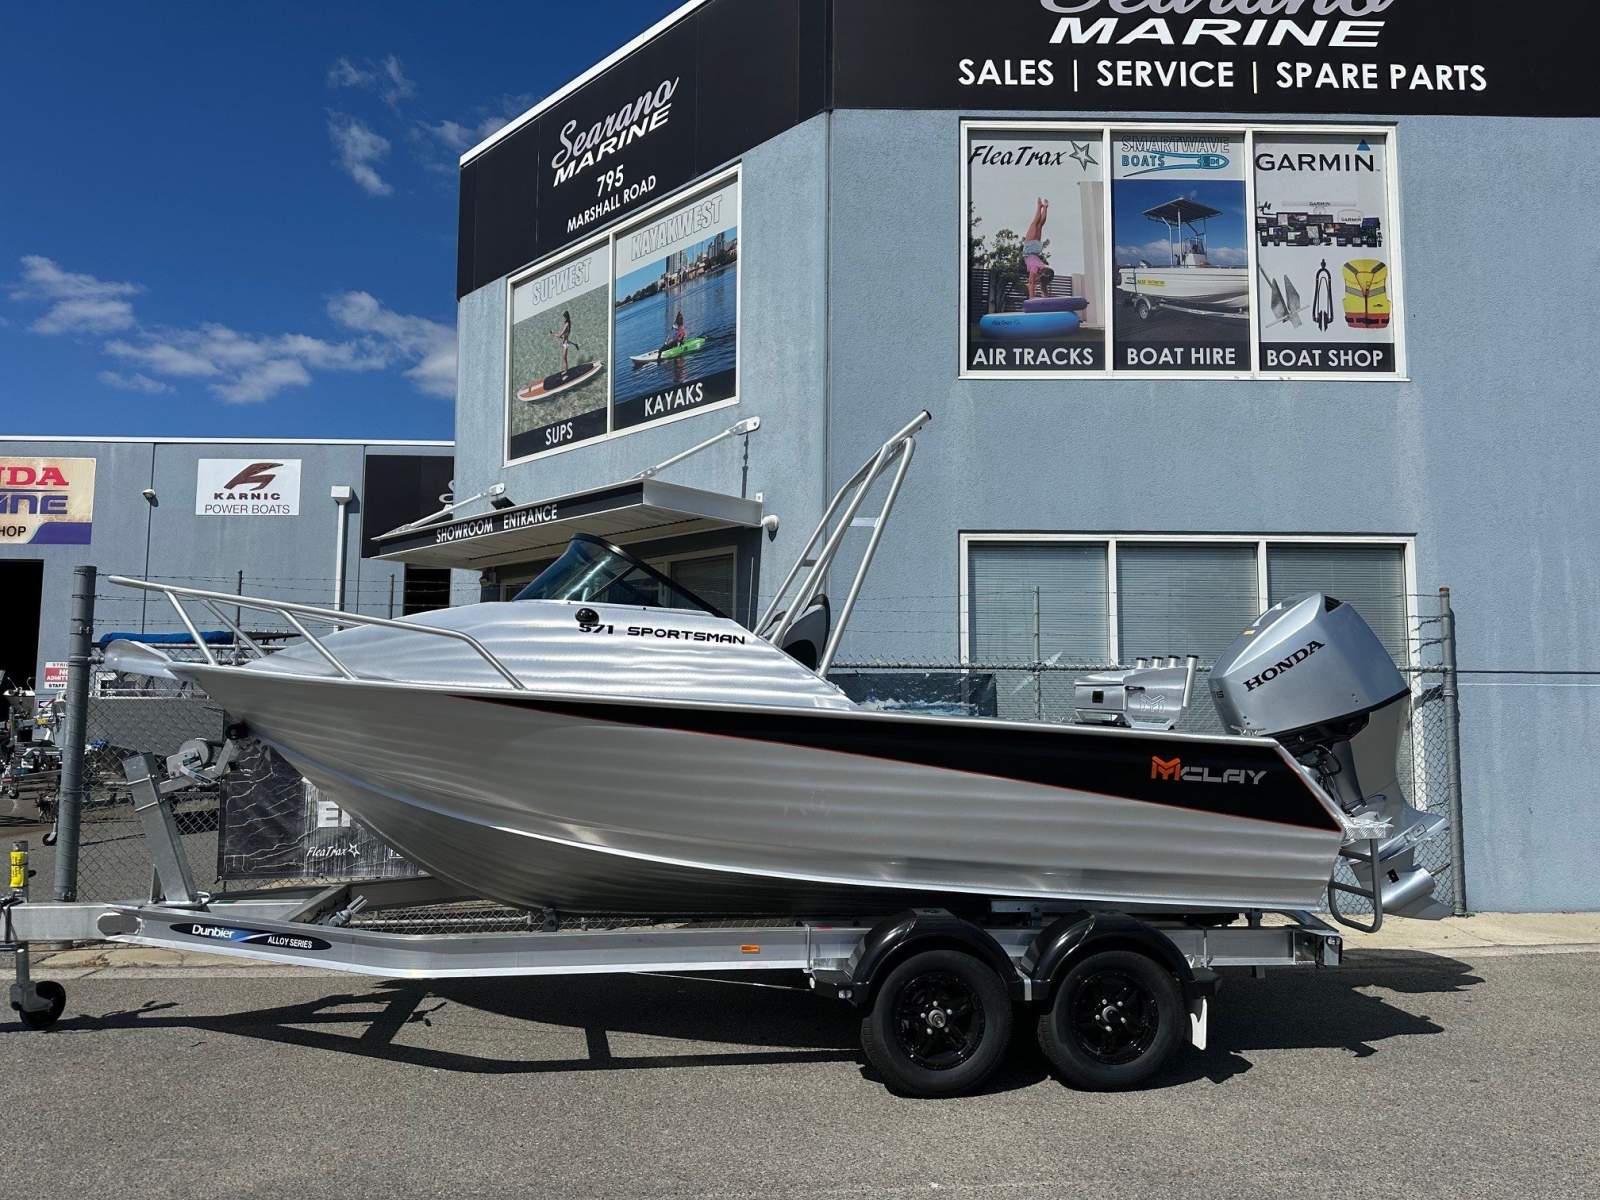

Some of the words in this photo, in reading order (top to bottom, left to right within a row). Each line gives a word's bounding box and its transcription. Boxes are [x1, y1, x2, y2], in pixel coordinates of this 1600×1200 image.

[1048, 17, 1386, 48] MARINE
[958, 58, 1054, 86] SALES
[1096, 60, 1234, 88] SERVICE
[1276, 61, 1378, 89] SPARE
[1389, 63, 1487, 91] PARTS
[551, 76, 680, 169] Searano
[553, 102, 673, 188] MARINE
[967, 144, 1070, 167] FleaTrax
[1121, 135, 1231, 153] SMARTWAVE
[1121, 154, 1166, 167] BOATS
[1254, 152, 1375, 172] GARMIN
[596, 164, 625, 197] 795
[567, 193, 621, 233] MARSHALL
[623, 174, 657, 204] ROAD
[631, 194, 723, 262] KAYAKWEST
[532, 257, 592, 305] SUPWEST
[972, 348, 1007, 365] AIR
[1013, 348, 1094, 365] TRACKS
[1127, 347, 1184, 366] BOAT
[1191, 347, 1236, 365] HIRE
[1266, 349, 1322, 367] BOAT
[1328, 349, 1384, 367] SHOP
[644, 382, 704, 417] KAYAKS
[545, 421, 573, 446] SUPS
[0, 467, 69, 486] DA
[213, 492, 281, 500] KARNIC
[205, 504, 248, 514] POWER
[251, 504, 290, 514] BOATS
[436, 517, 494, 543] SHOWROOM
[503, 504, 558, 530] ENTRANCE
[579, 622, 614, 635] 571
[627, 626, 746, 645] SPORTSMAN
[1242, 640, 1326, 692] HONDA
[306, 844, 348, 857] FleaTrax
[191, 924, 235, 939] Dunbier
[267, 936, 290, 946] ALLOY
[289, 938, 313, 949] SERIES
